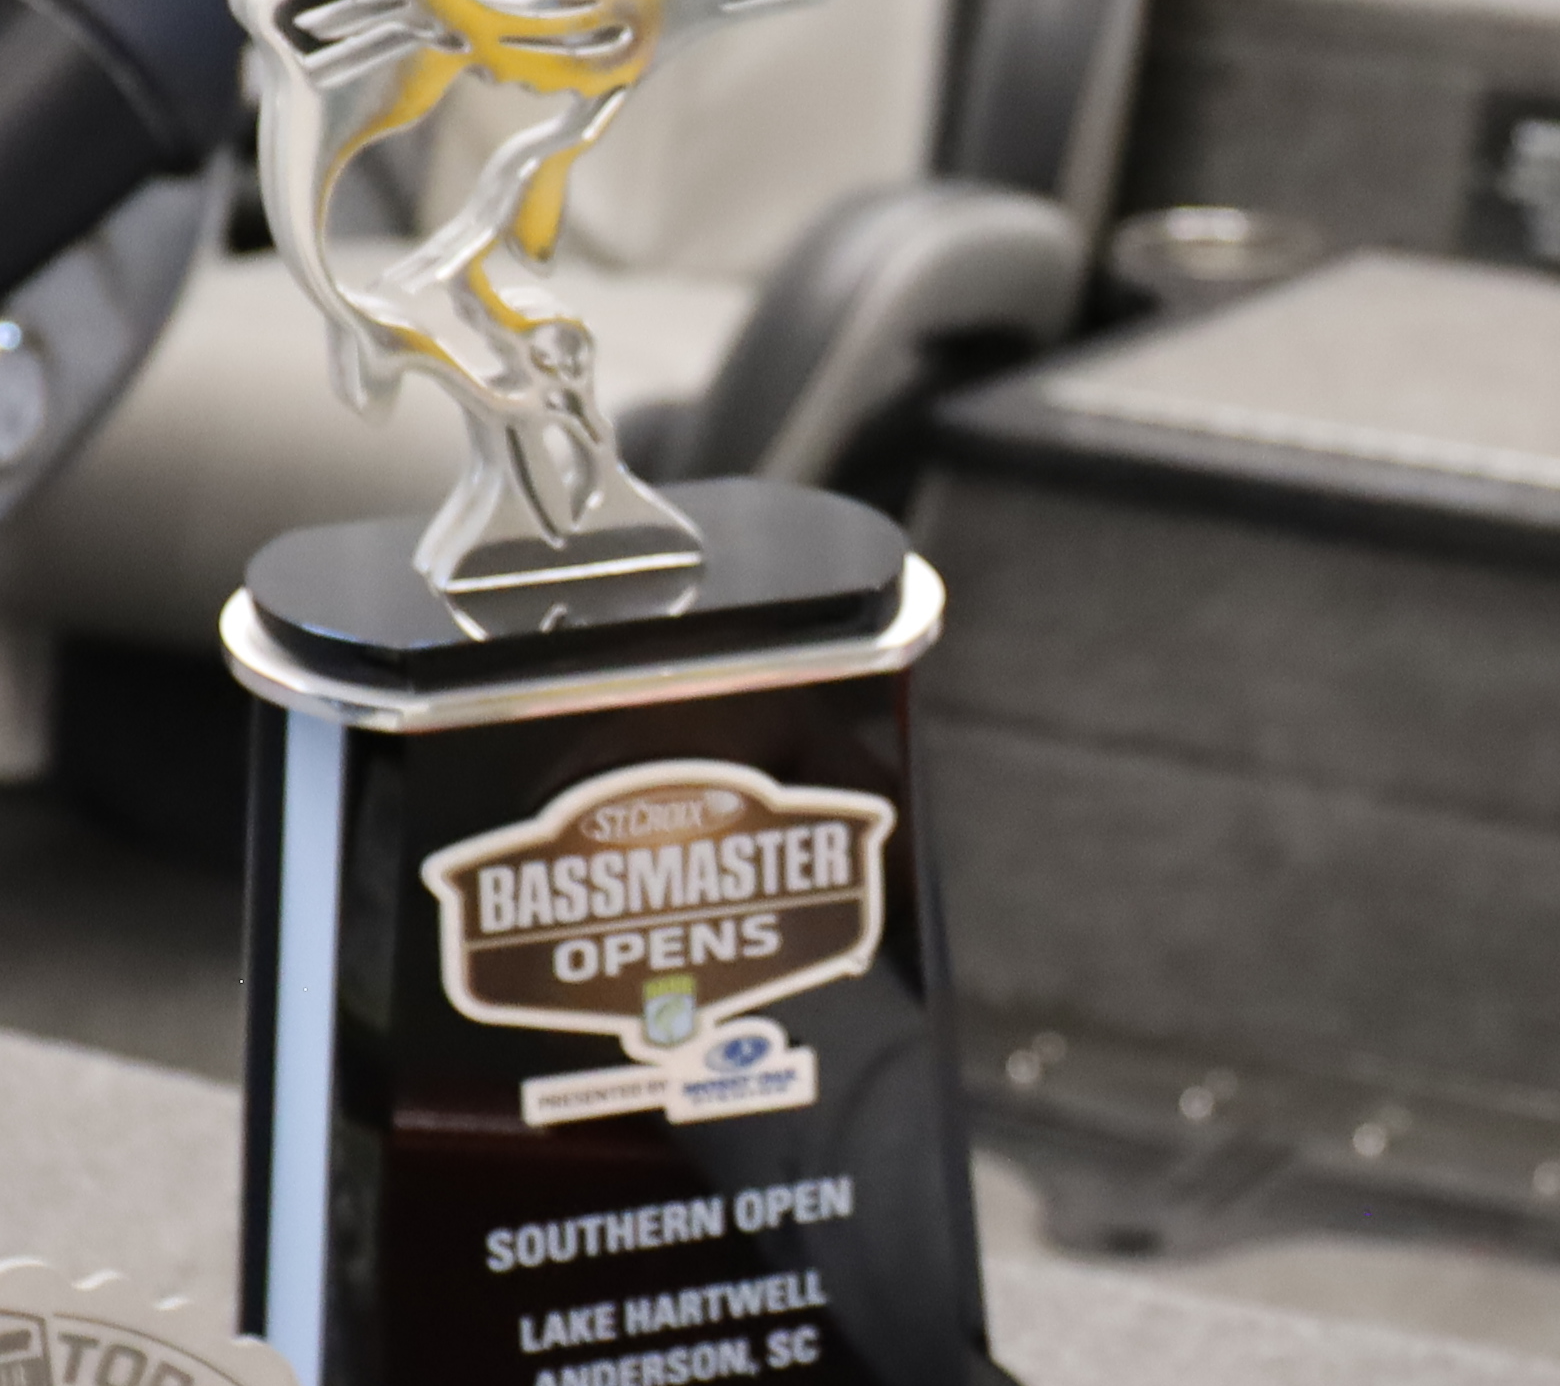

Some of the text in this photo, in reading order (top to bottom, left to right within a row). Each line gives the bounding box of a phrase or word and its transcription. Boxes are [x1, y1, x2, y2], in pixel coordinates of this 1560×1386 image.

[477, 821, 851, 934] BASSMASTER
[554, 914, 782, 984] OPENS
[485, 1174, 854, 1273] SOUTHERN OPEN
[519, 1268, 827, 1354] LAKE HARTWELL
[766, 1324, 820, 1370] SC
